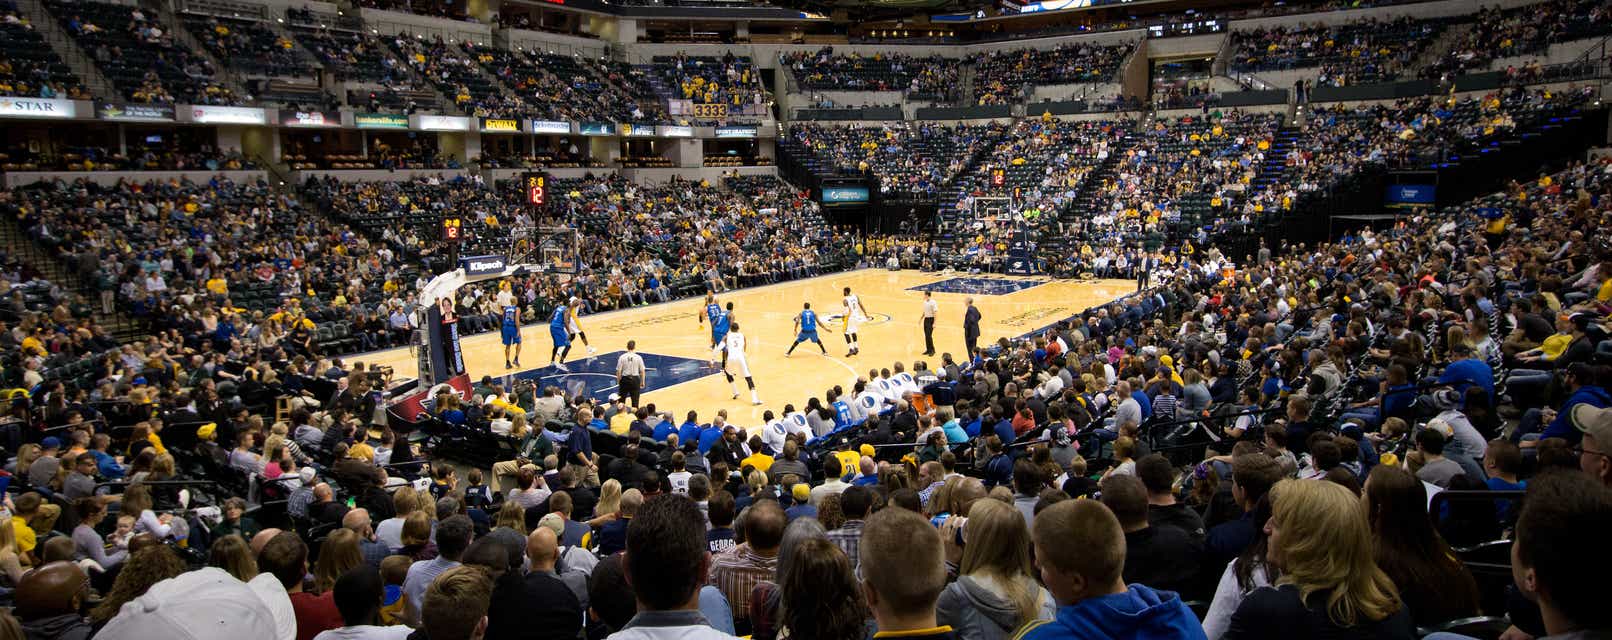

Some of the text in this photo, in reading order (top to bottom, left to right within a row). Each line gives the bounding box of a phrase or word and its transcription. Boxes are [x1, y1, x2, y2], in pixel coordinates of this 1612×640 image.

[15, 101, 56, 111] STAR
[695, 105, 727, 117] 3333
[533, 187, 543, 203] 12
[470, 260, 504, 271] Klipsch
